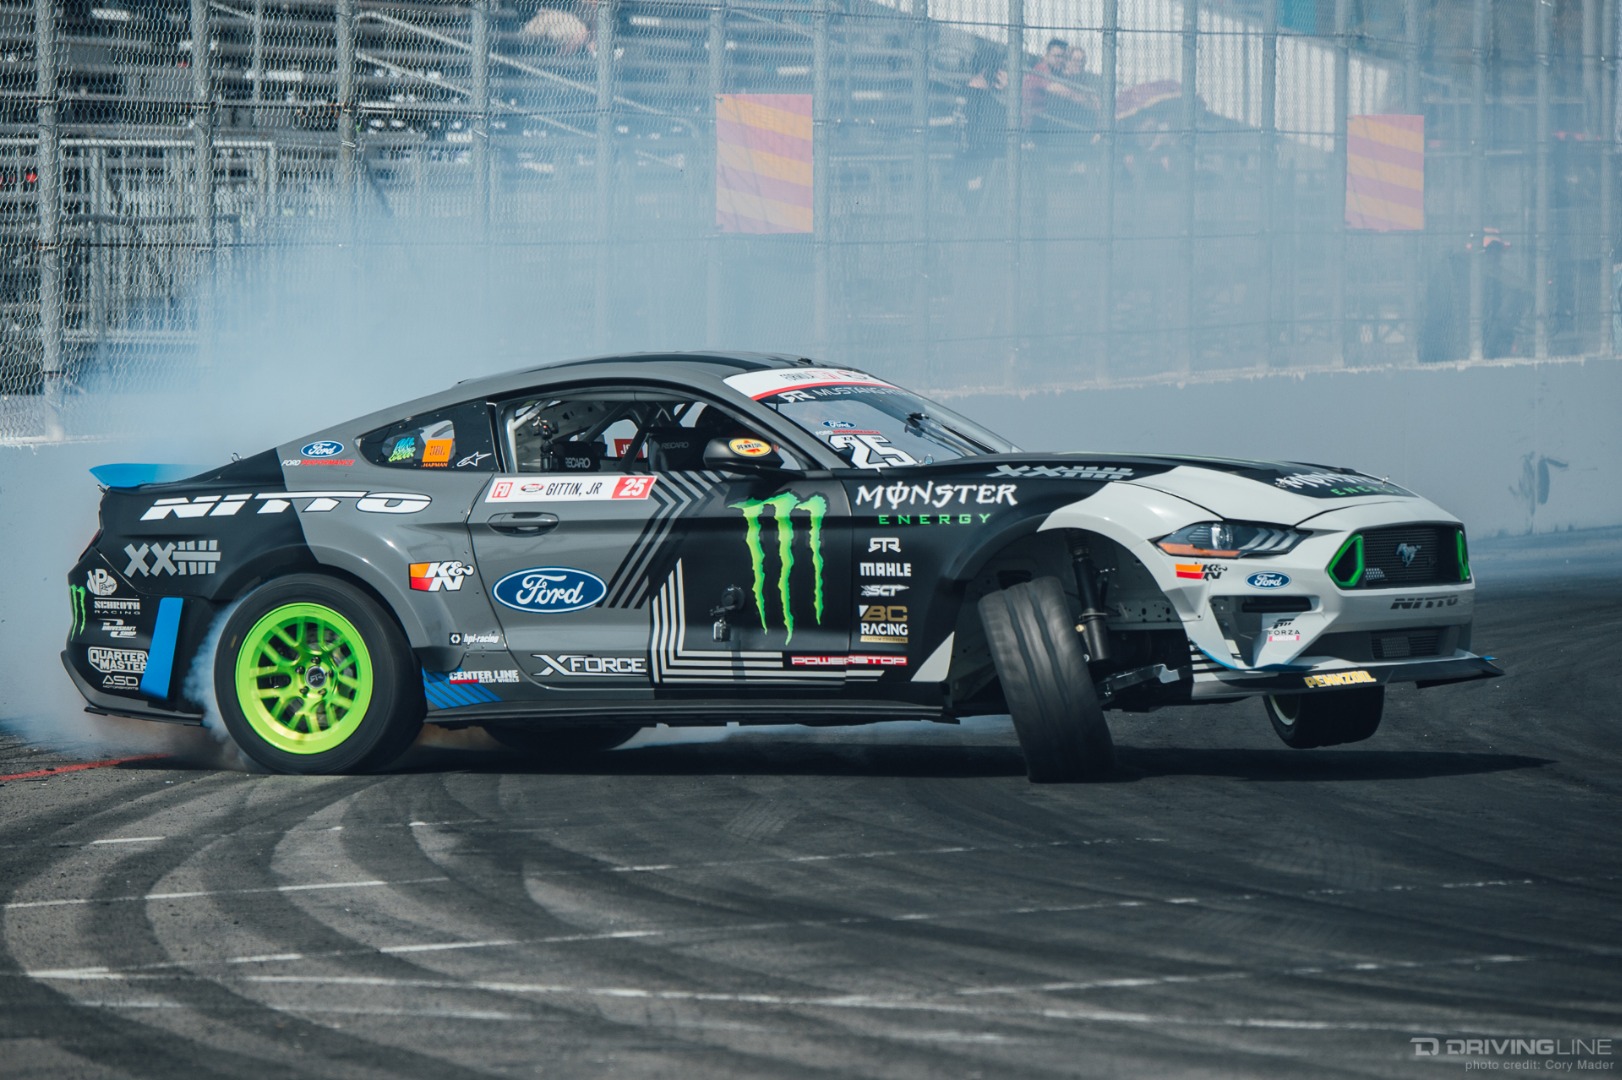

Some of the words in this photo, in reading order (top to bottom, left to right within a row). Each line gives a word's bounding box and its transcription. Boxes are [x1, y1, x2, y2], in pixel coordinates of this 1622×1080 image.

[429, 446, 445, 456] JBL
[828, 434, 919, 469] 25
[281, 459, 301, 467] FORD
[301, 459, 355, 467] PERFORMANCE
[545, 483, 582, 496] GITTIN,
[586, 483, 603, 495] JR
[619, 478, 648, 497] 25
[855, 480, 1018, 509] MONSTER
[140, 491, 432, 521] NITTO
[878, 513, 991, 525] ENERGY
[427, 561, 473, 592] K&N
[860, 562, 911, 577] MAHLE
[515, 574, 585, 605] Ford
[94, 600, 141, 610] SCHROTH
[1389, 595, 1459, 610] NITTO
[861, 605, 908, 622] BC
[860, 623, 909, 636] RACING
[90, 649, 147, 664] QUARTER
[530, 653, 649, 677] XFORCE
[102, 675, 139, 686] ASD
[449, 670, 491, 680] CENTER
[493, 670, 519, 679] LINE
[1303, 670, 1377, 689] PENNZOIL
